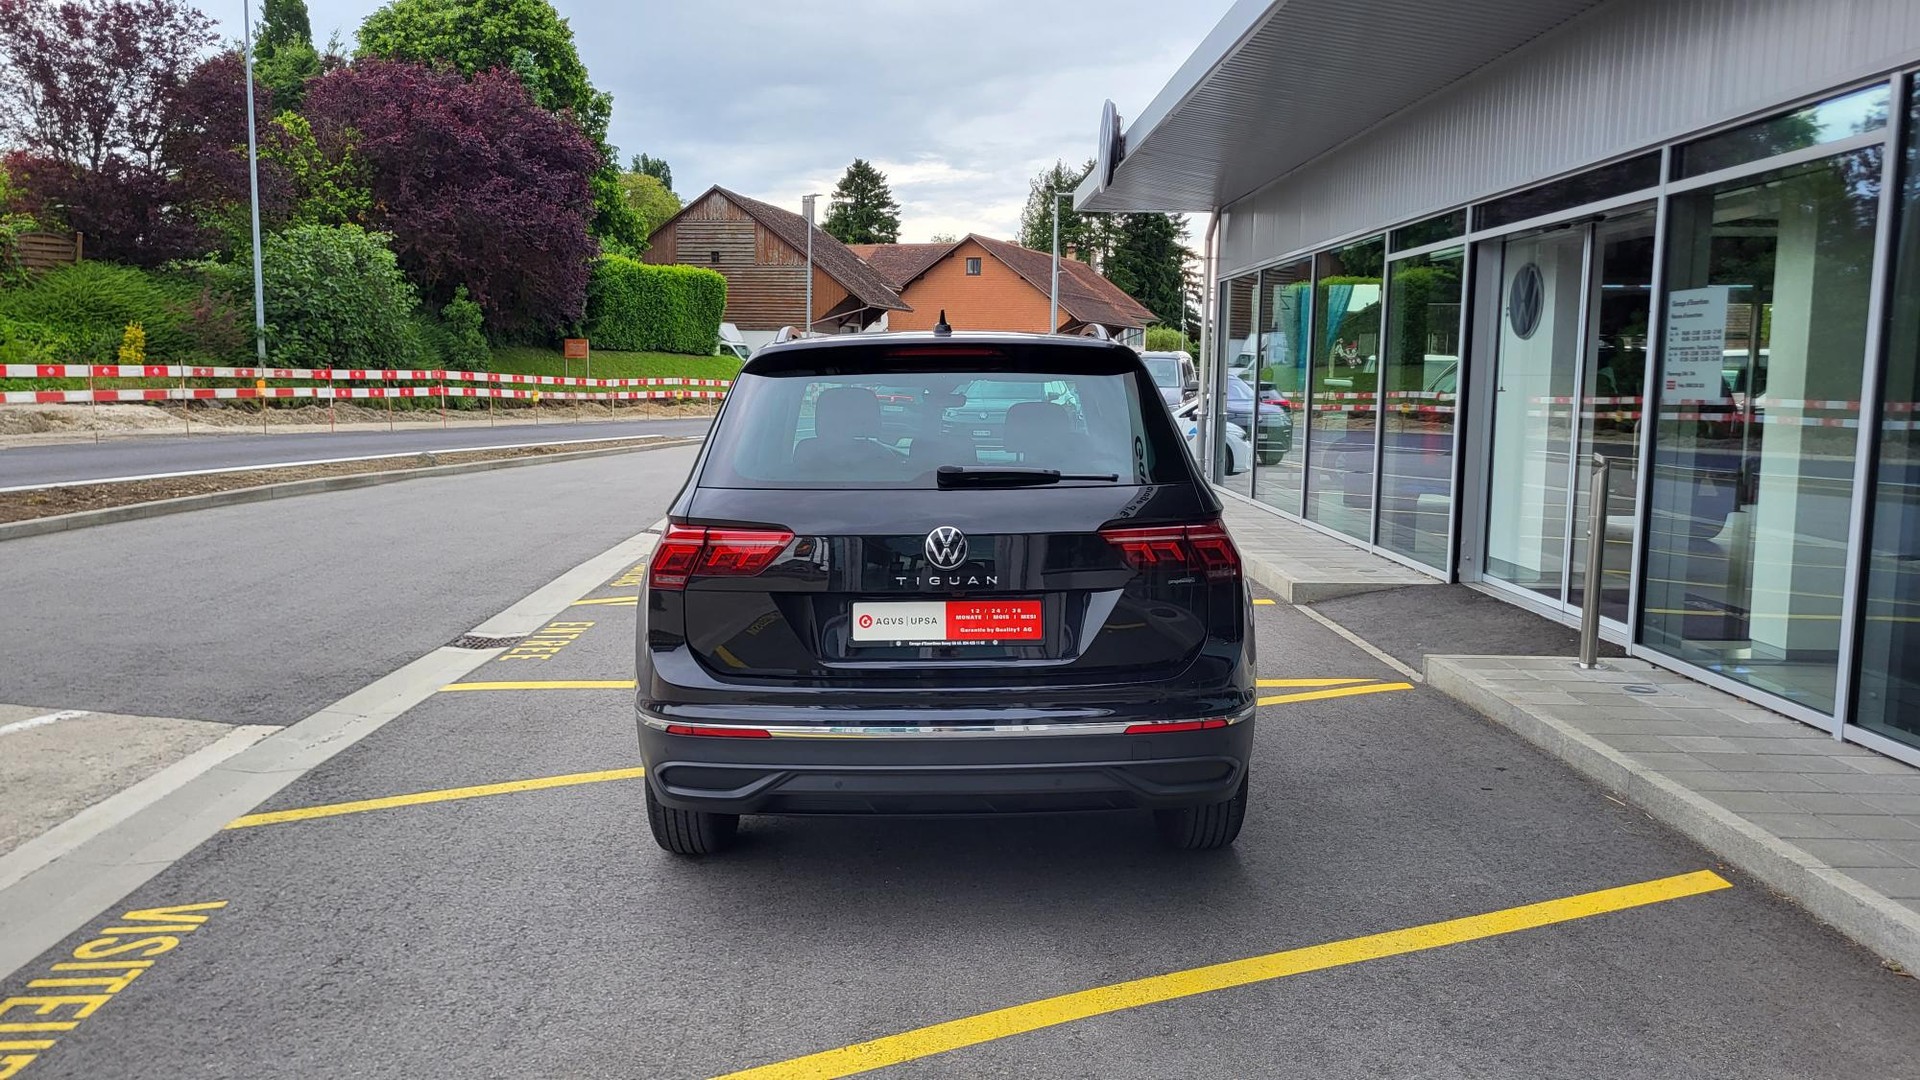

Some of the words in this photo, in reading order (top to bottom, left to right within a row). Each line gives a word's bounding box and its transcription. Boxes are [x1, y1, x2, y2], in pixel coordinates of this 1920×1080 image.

[895, 576, 998, 586] TIGUAN
[875, 617, 904, 626] AGVS
[911, 616, 938, 625] UPSA
[498, 621, 596, 661] ENTREE
